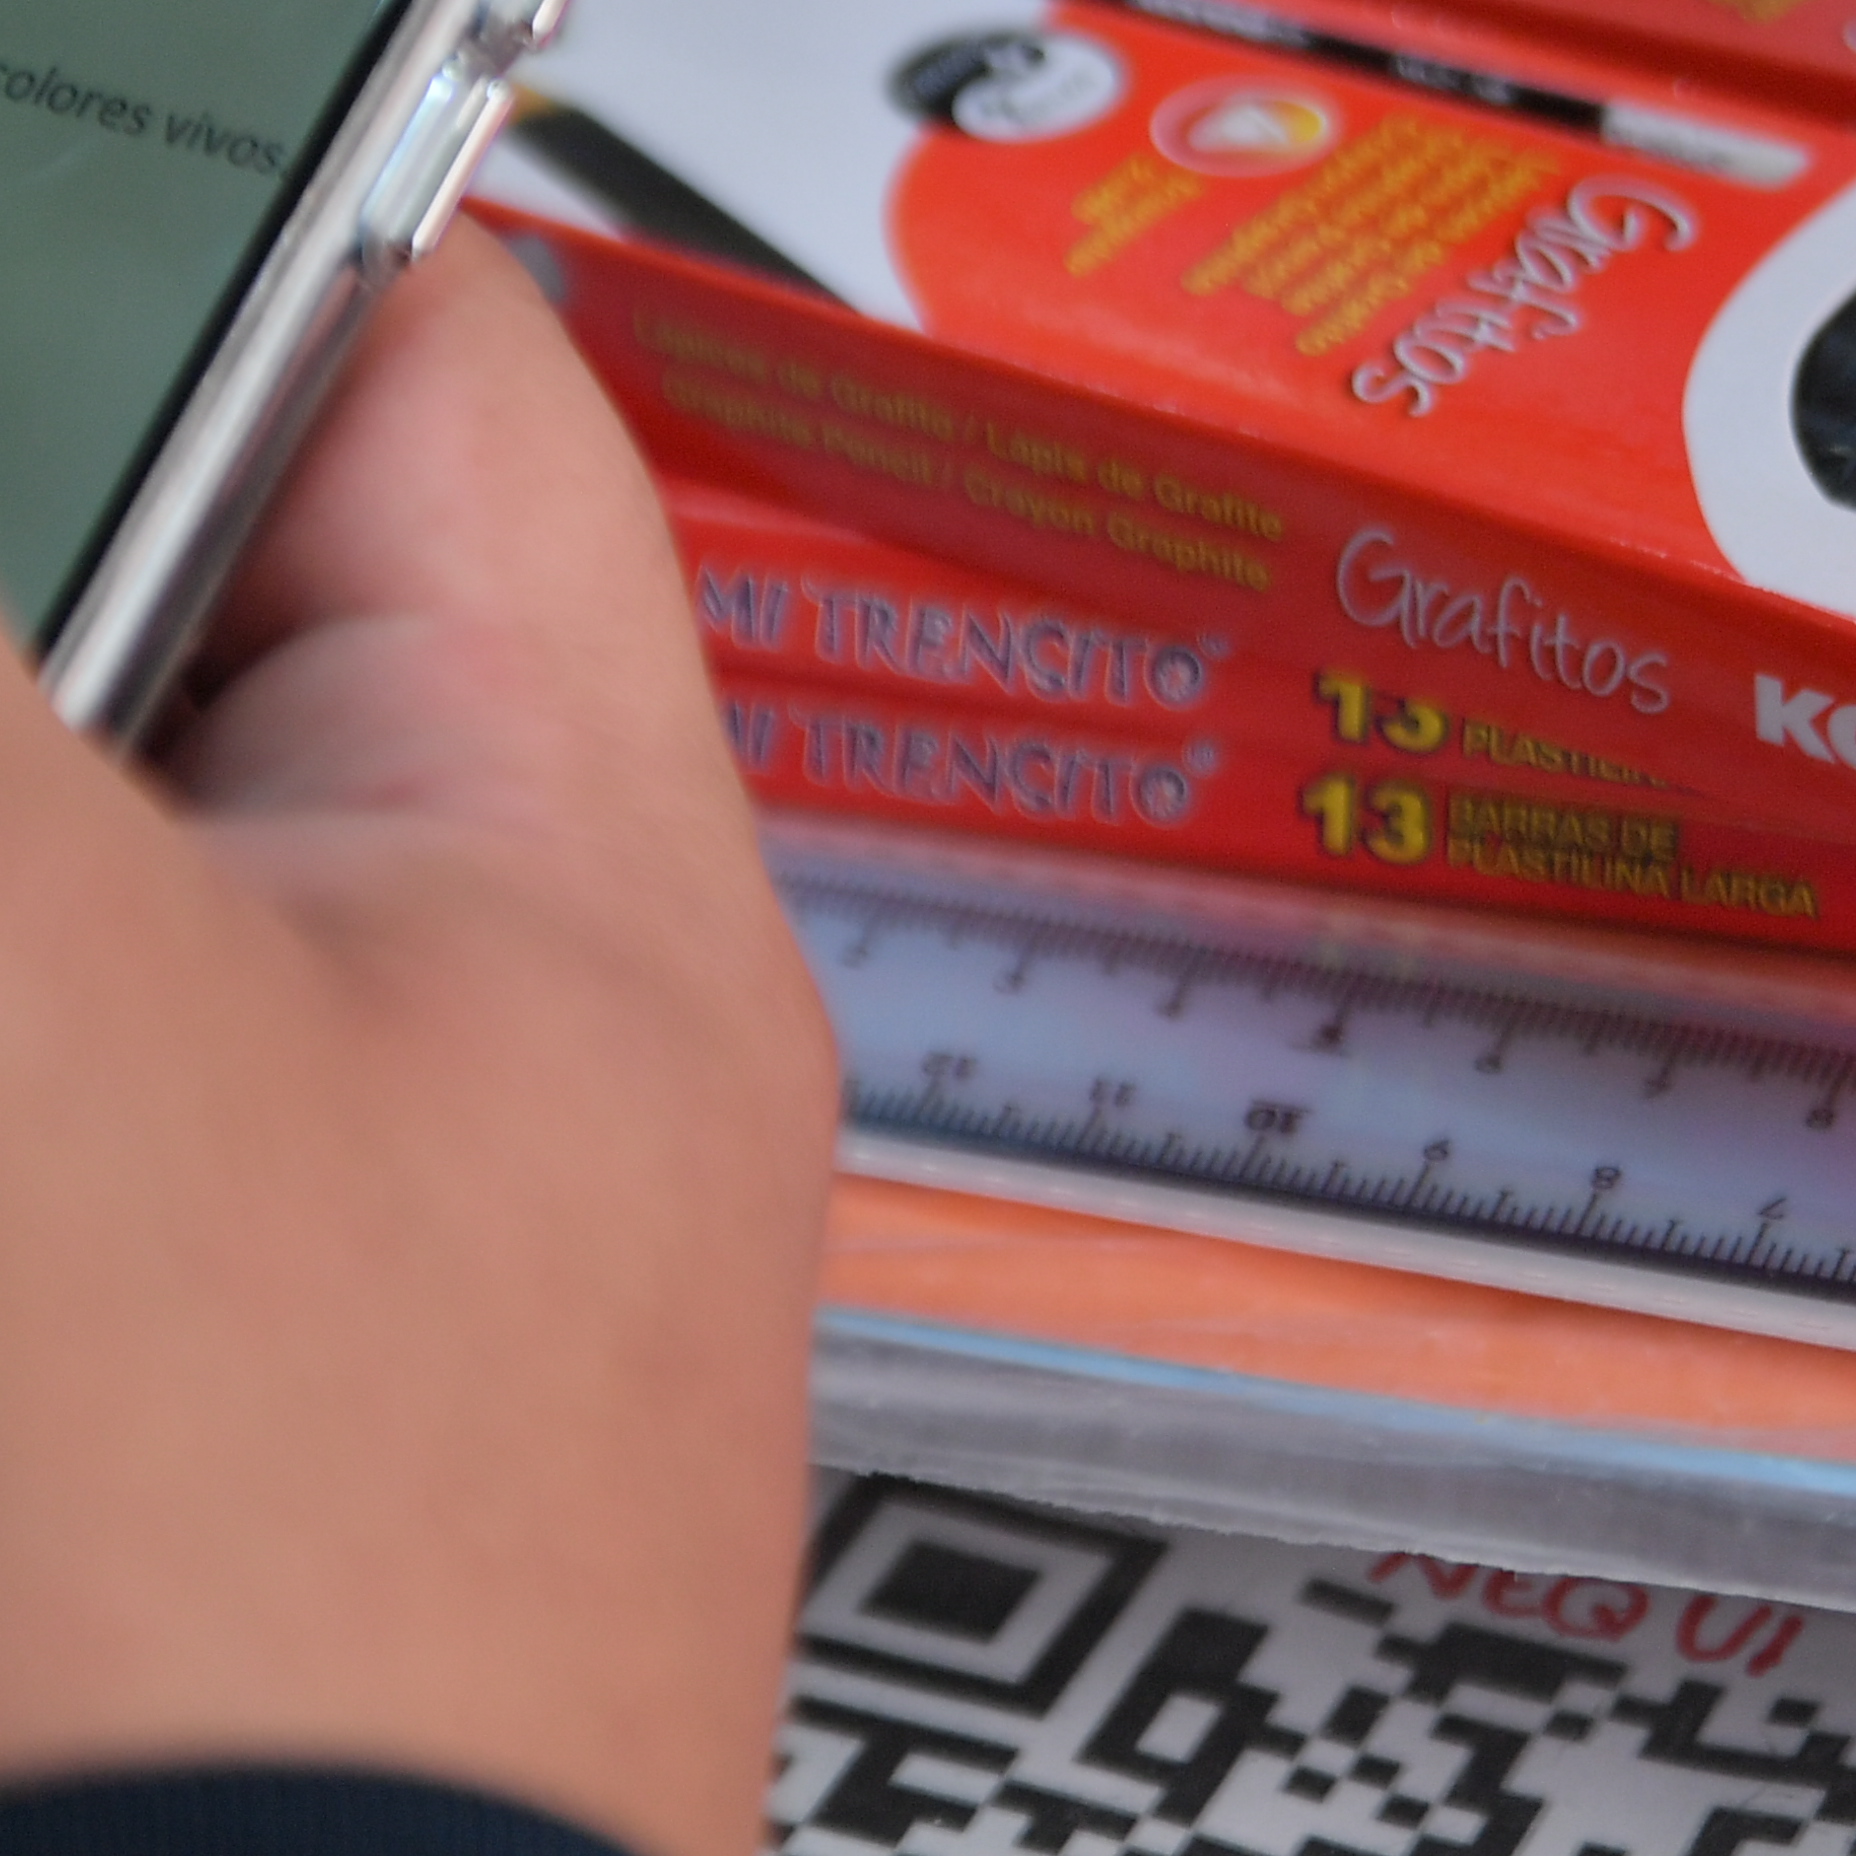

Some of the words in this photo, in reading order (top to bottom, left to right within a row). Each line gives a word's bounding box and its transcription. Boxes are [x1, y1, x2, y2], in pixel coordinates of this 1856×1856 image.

[1350, 175, 1697, 418] Grafitos
[696, 563, 788, 652] MI
[1337, 528, 1671, 714] Grafitos
[1301, 770, 1434, 866] 13
[1447, 790, 1616, 851] BARRAS
[1621, 809, 1681, 862] DE
[1448, 834, 1671, 900] PLASTILINA
[1681, 864, 1821, 921] LARGA
